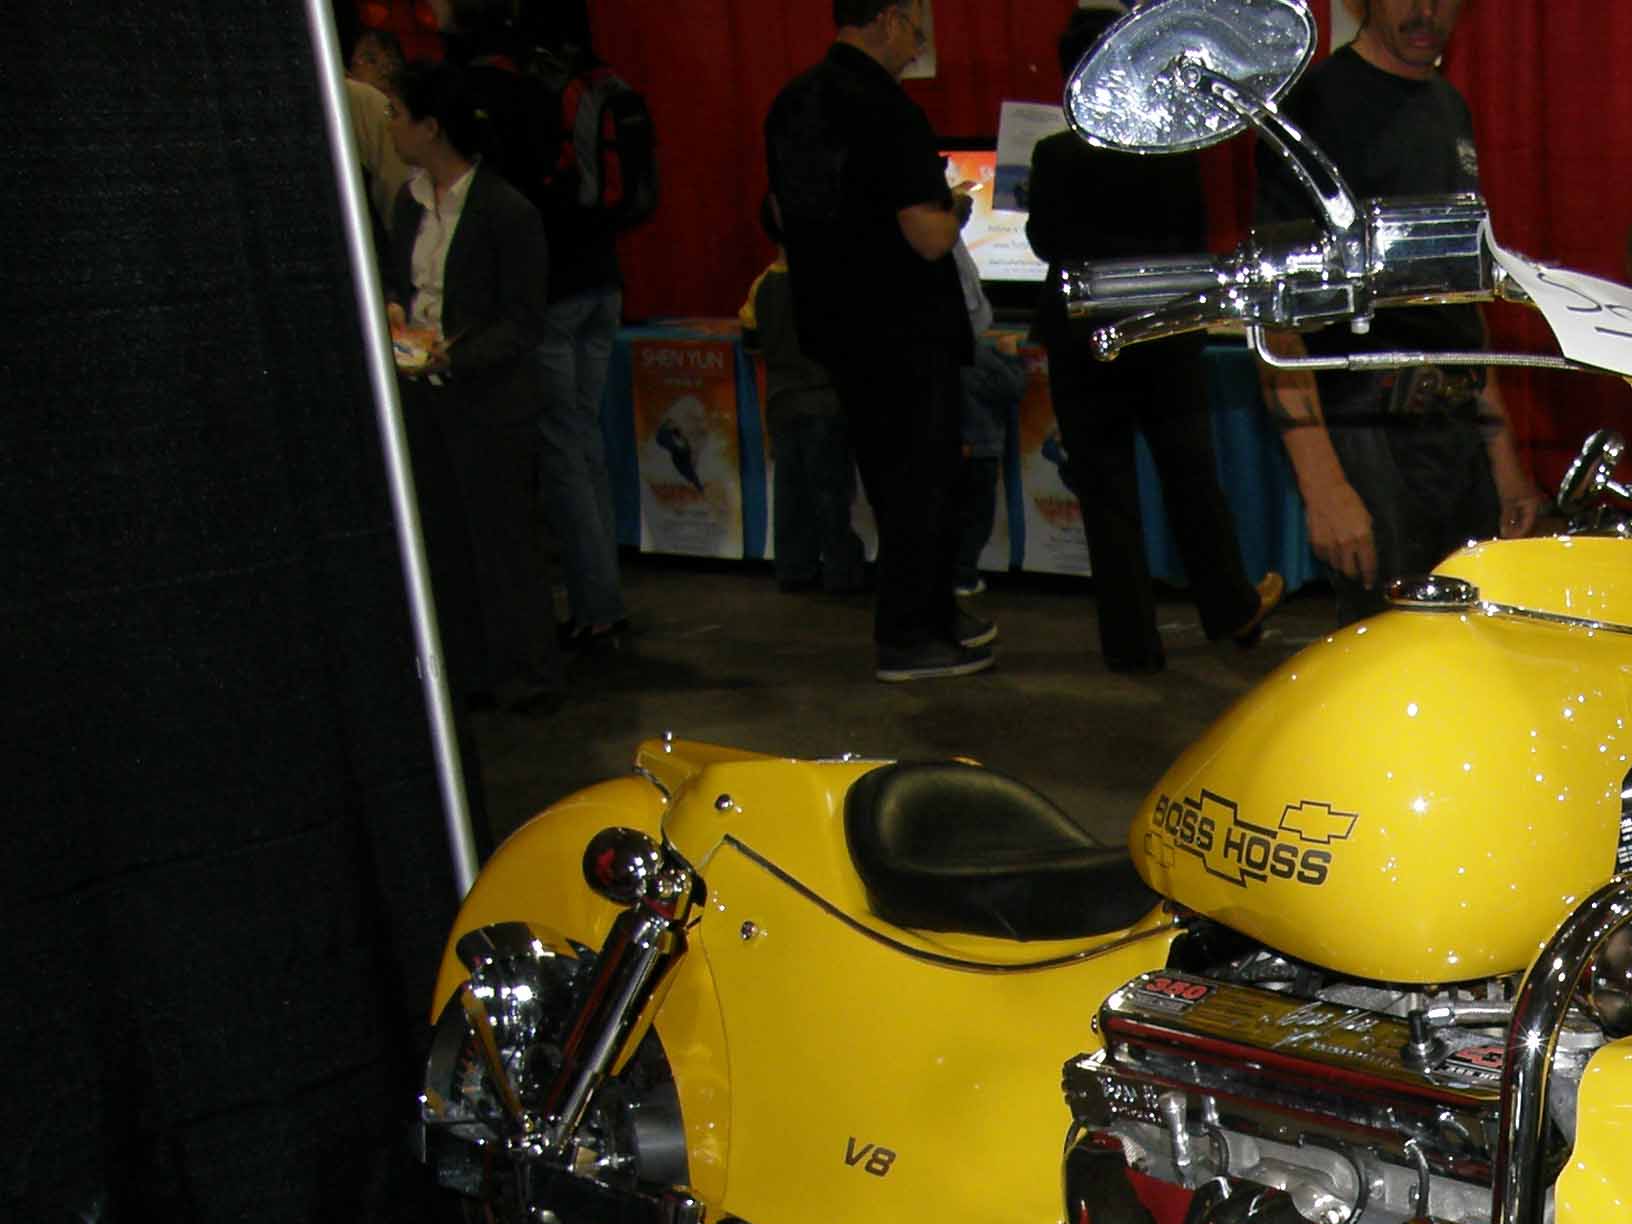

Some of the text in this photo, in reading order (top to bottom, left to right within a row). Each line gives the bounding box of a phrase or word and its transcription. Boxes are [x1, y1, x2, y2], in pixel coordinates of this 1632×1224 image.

[640, 349, 724, 370] SHEN YUN
[1152, 792, 1334, 887] BOSS HOSS
[844, 1135, 898, 1178] V8
